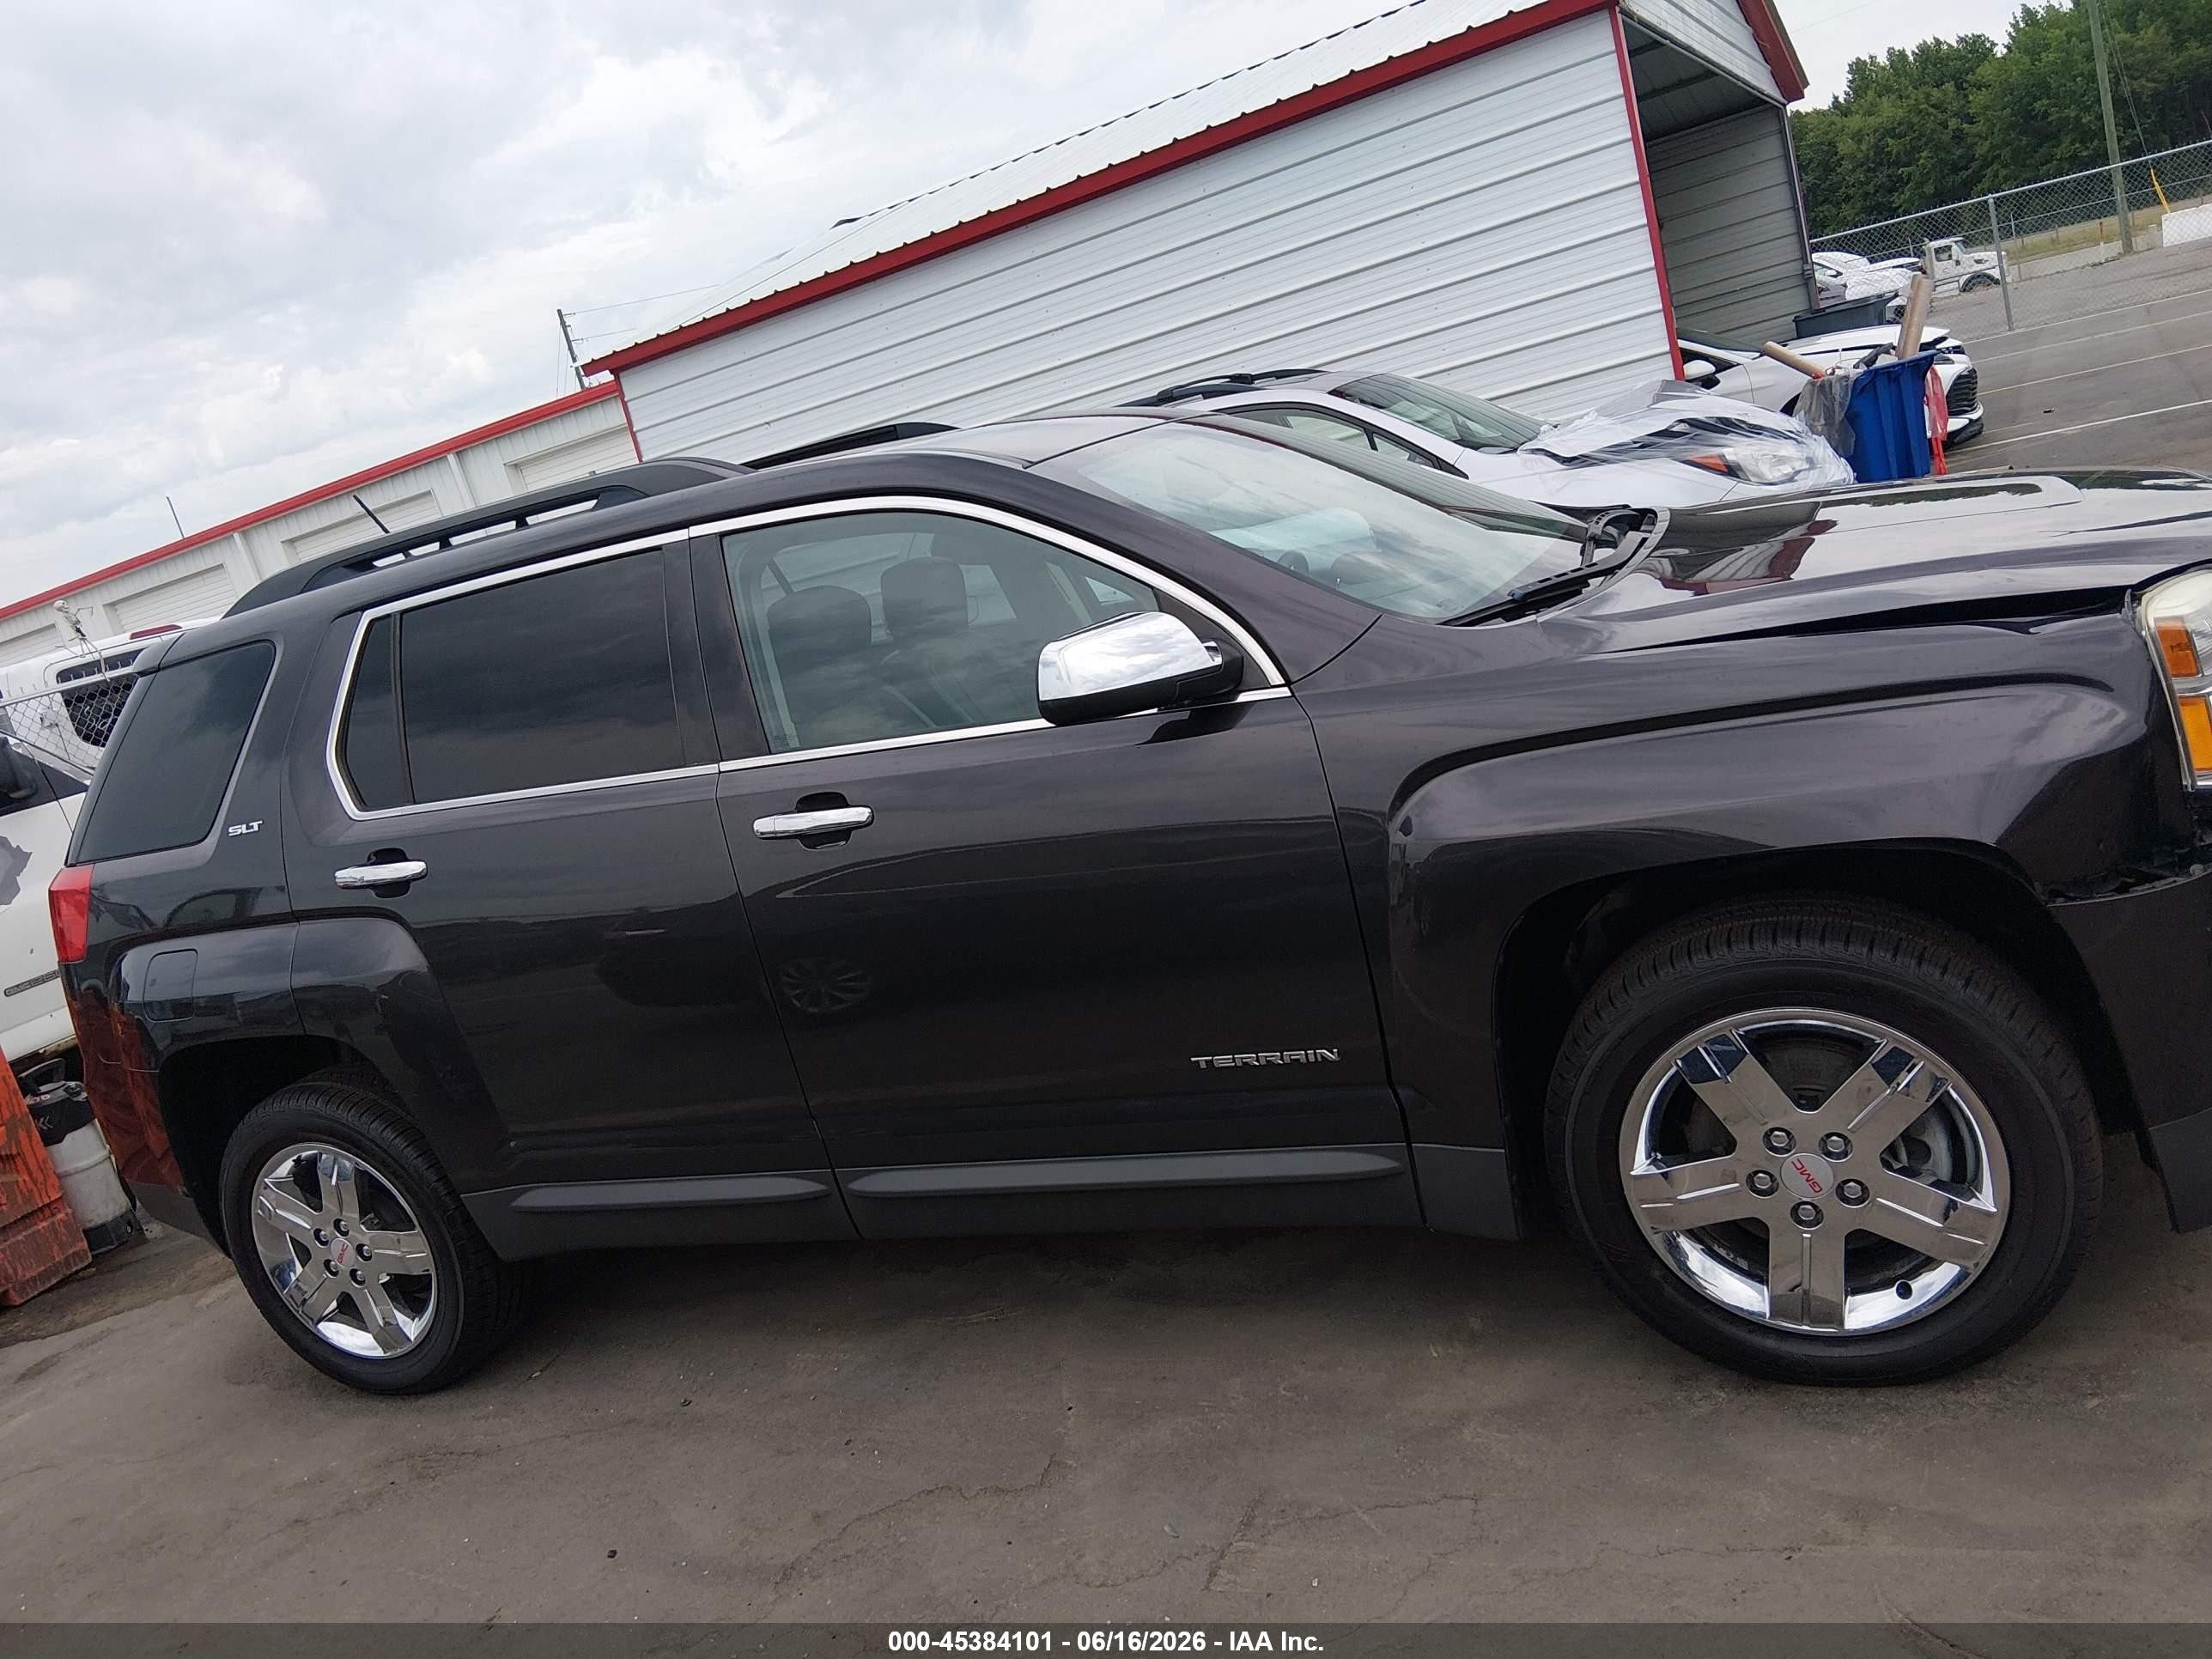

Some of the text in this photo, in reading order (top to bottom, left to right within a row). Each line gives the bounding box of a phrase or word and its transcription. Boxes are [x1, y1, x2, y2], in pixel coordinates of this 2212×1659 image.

[228, 820, 263, 836] SLT
[1190, 1048, 1340, 1069] TERRAIN
[1791, 1158, 1823, 1193] GMC
